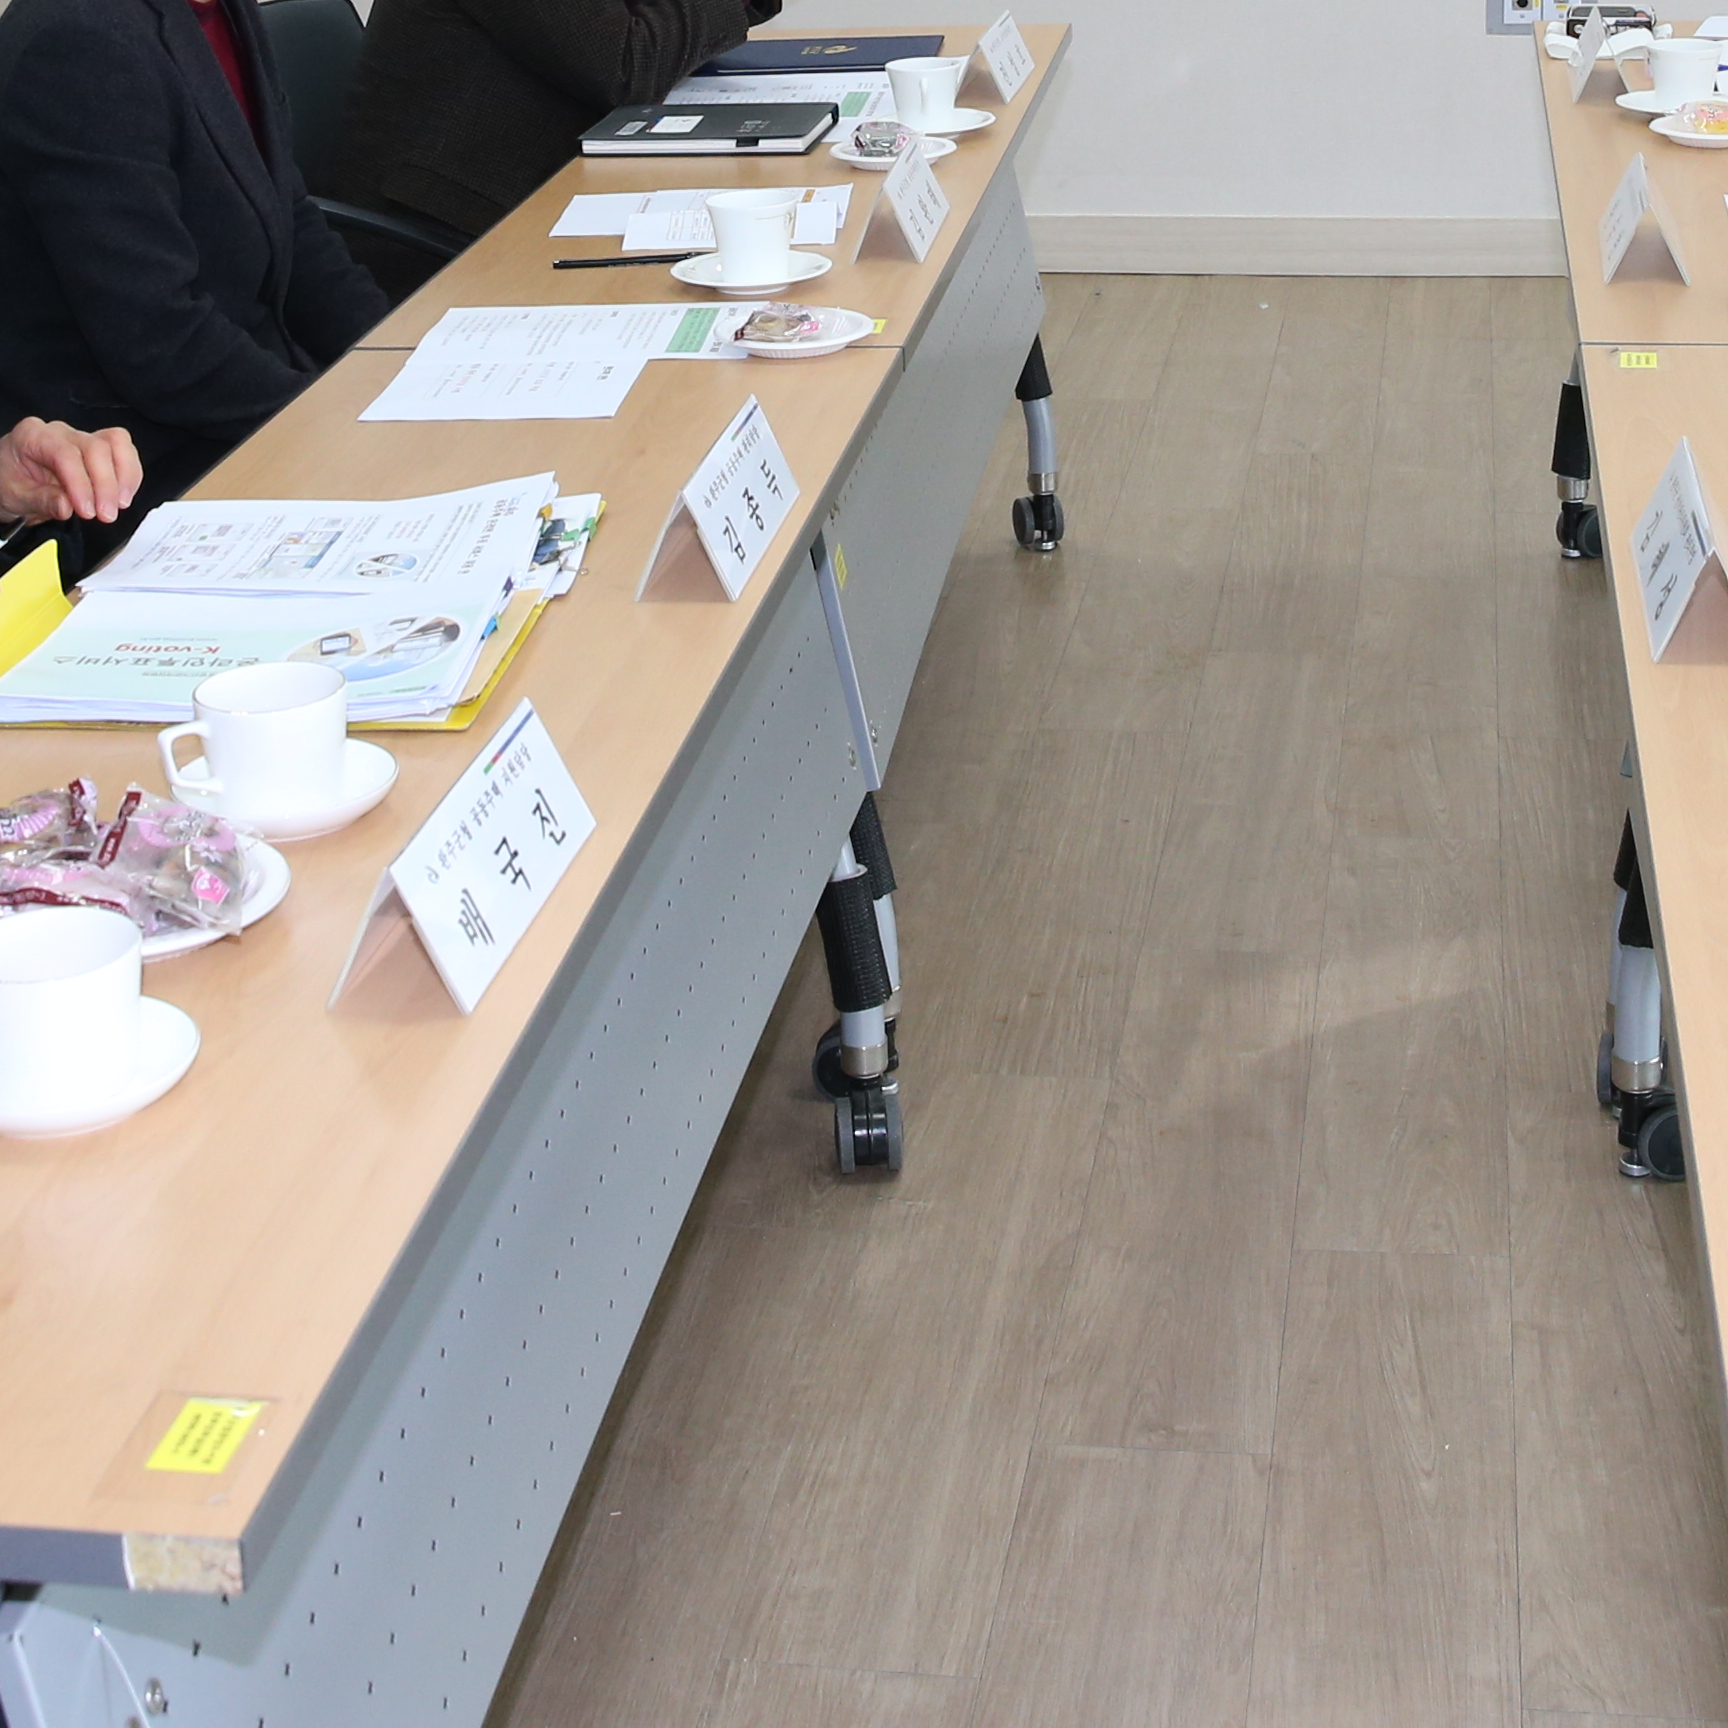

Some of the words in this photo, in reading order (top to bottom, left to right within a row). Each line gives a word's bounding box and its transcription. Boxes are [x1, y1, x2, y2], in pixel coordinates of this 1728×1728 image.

[722, 516, 746, 564] 김
[742, 487, 765, 531] 종
[52, 655, 260, 668] 온라인투표서비스
[114, 643, 221, 655] K-voting
[438, 820, 473, 869] 완주군청
[470, 780, 502, 827] 공동주택
[458, 888, 495, 946] 배
[494, 836, 531, 889] 국
[531, 788, 567, 846] 진
